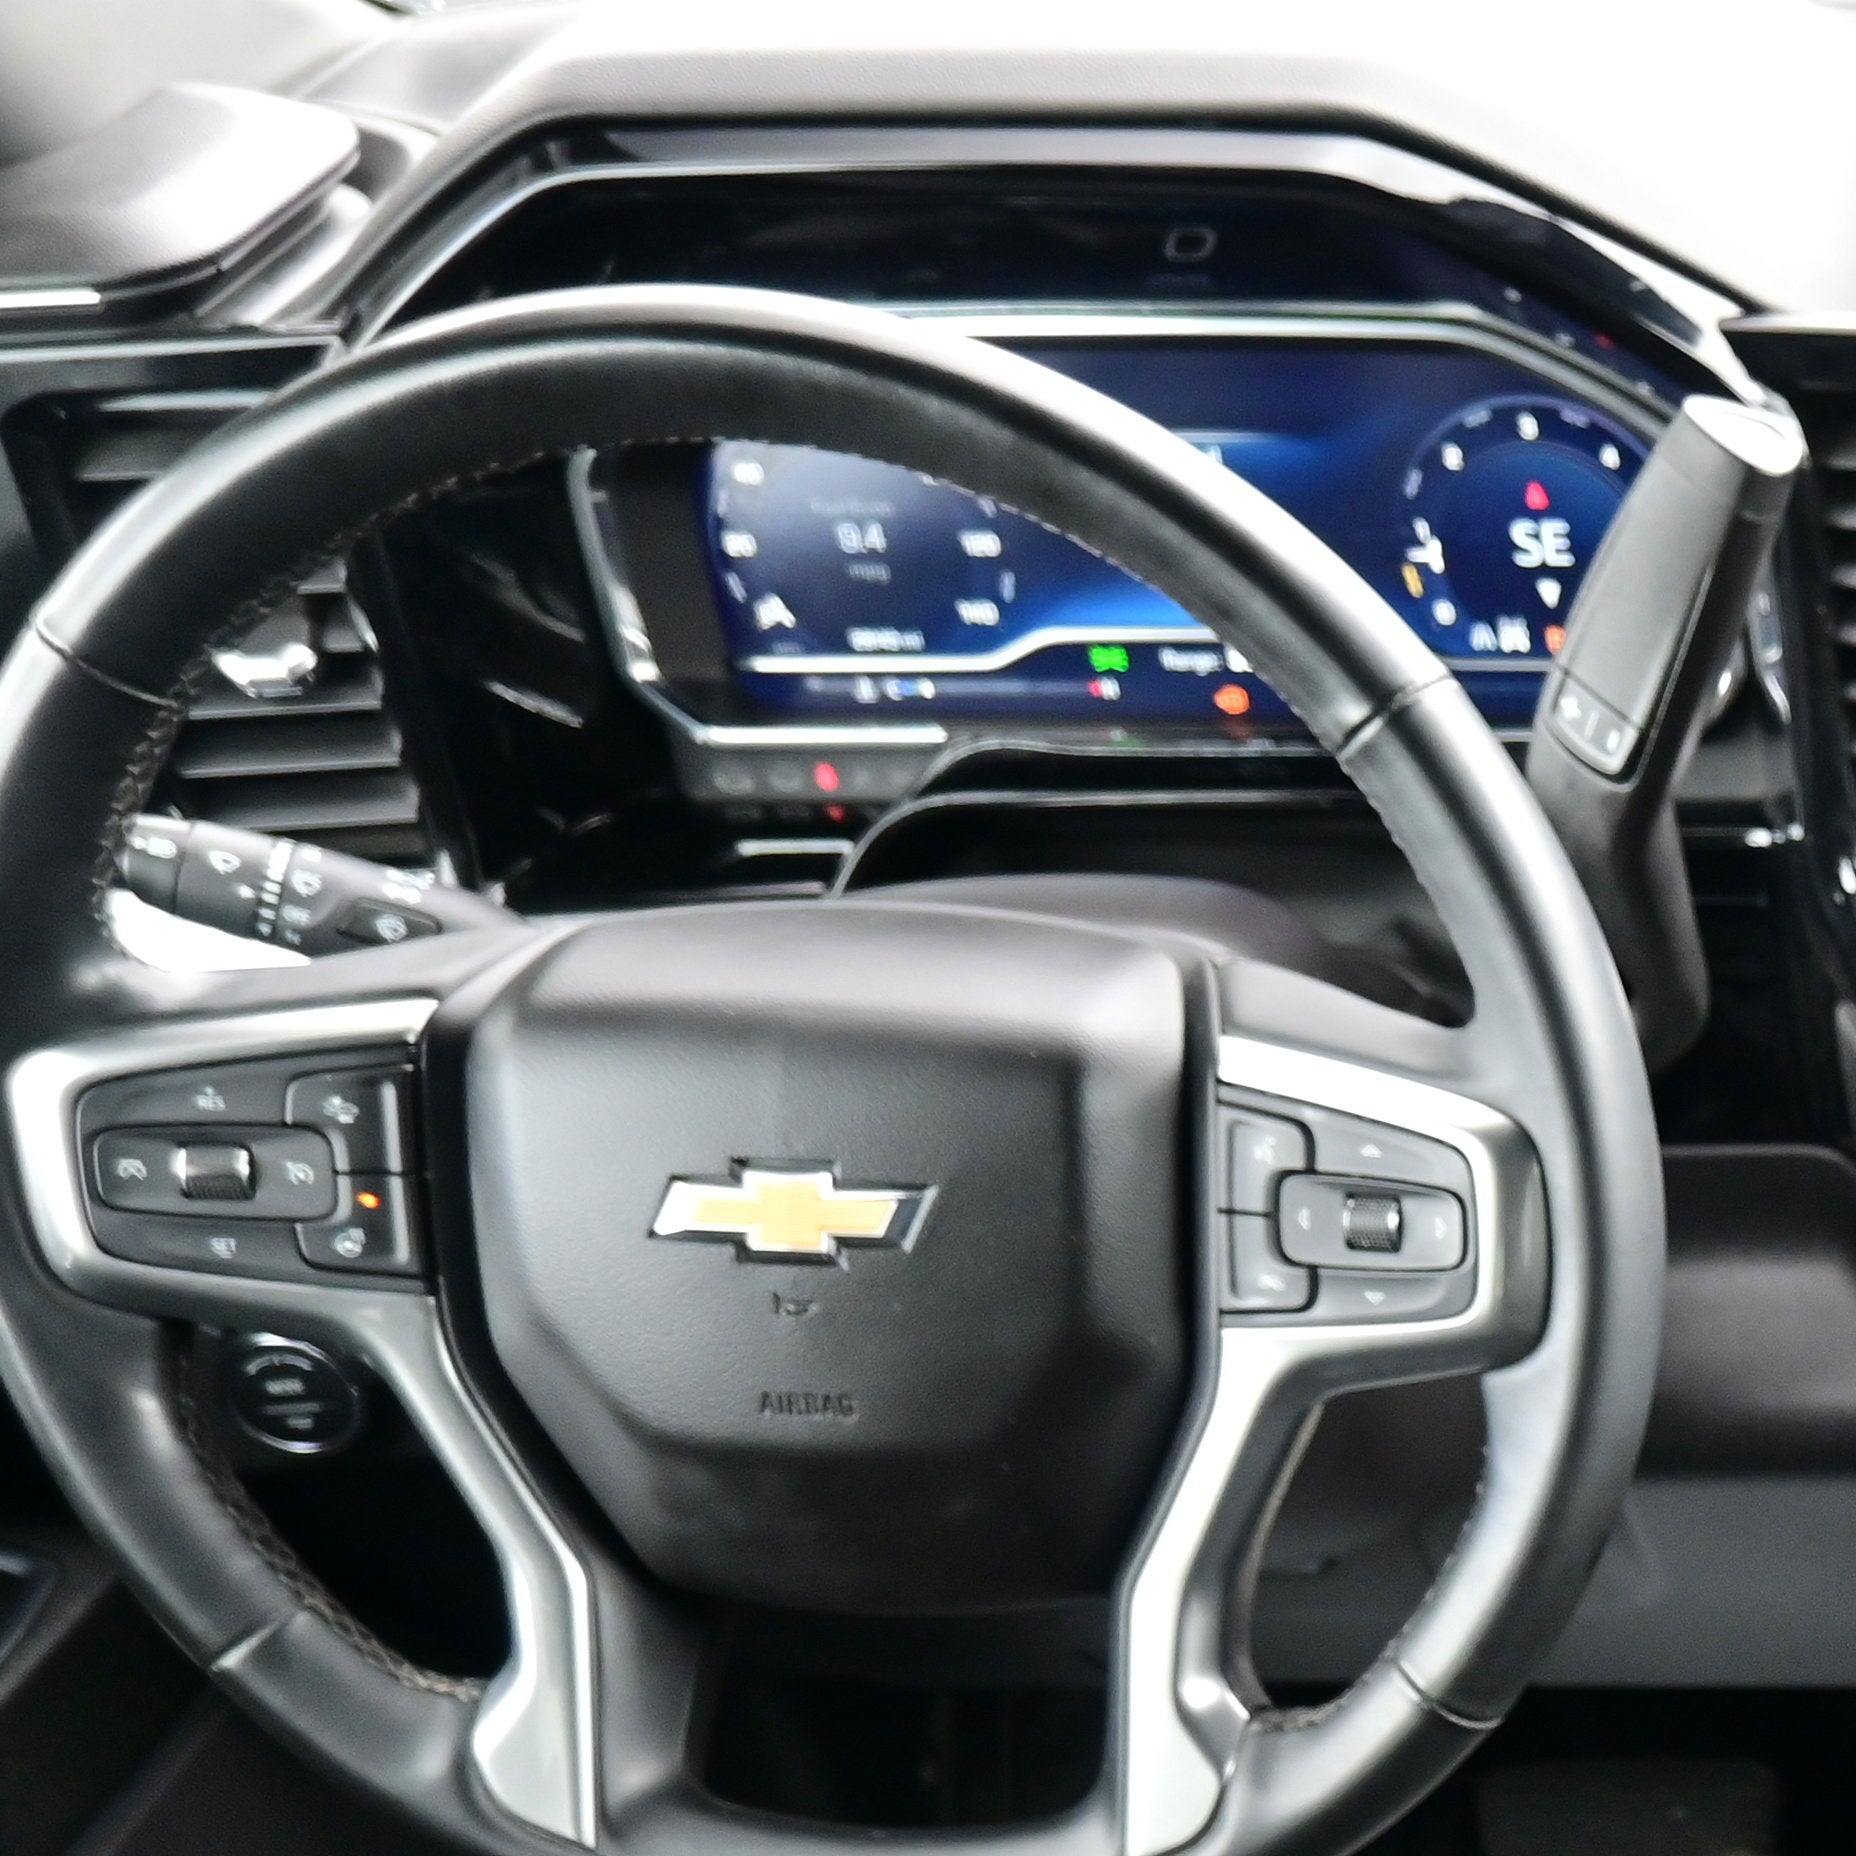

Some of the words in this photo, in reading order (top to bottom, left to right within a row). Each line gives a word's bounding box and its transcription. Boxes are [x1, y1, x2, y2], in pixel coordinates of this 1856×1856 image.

[1516, 411, 1539, 441] 3
[1508, 517, 1576, 568] SE
[196, 1094, 226, 1112] RES
[210, 1237, 237, 1253] SET
[760, 1390, 853, 1416] AIRBAG
